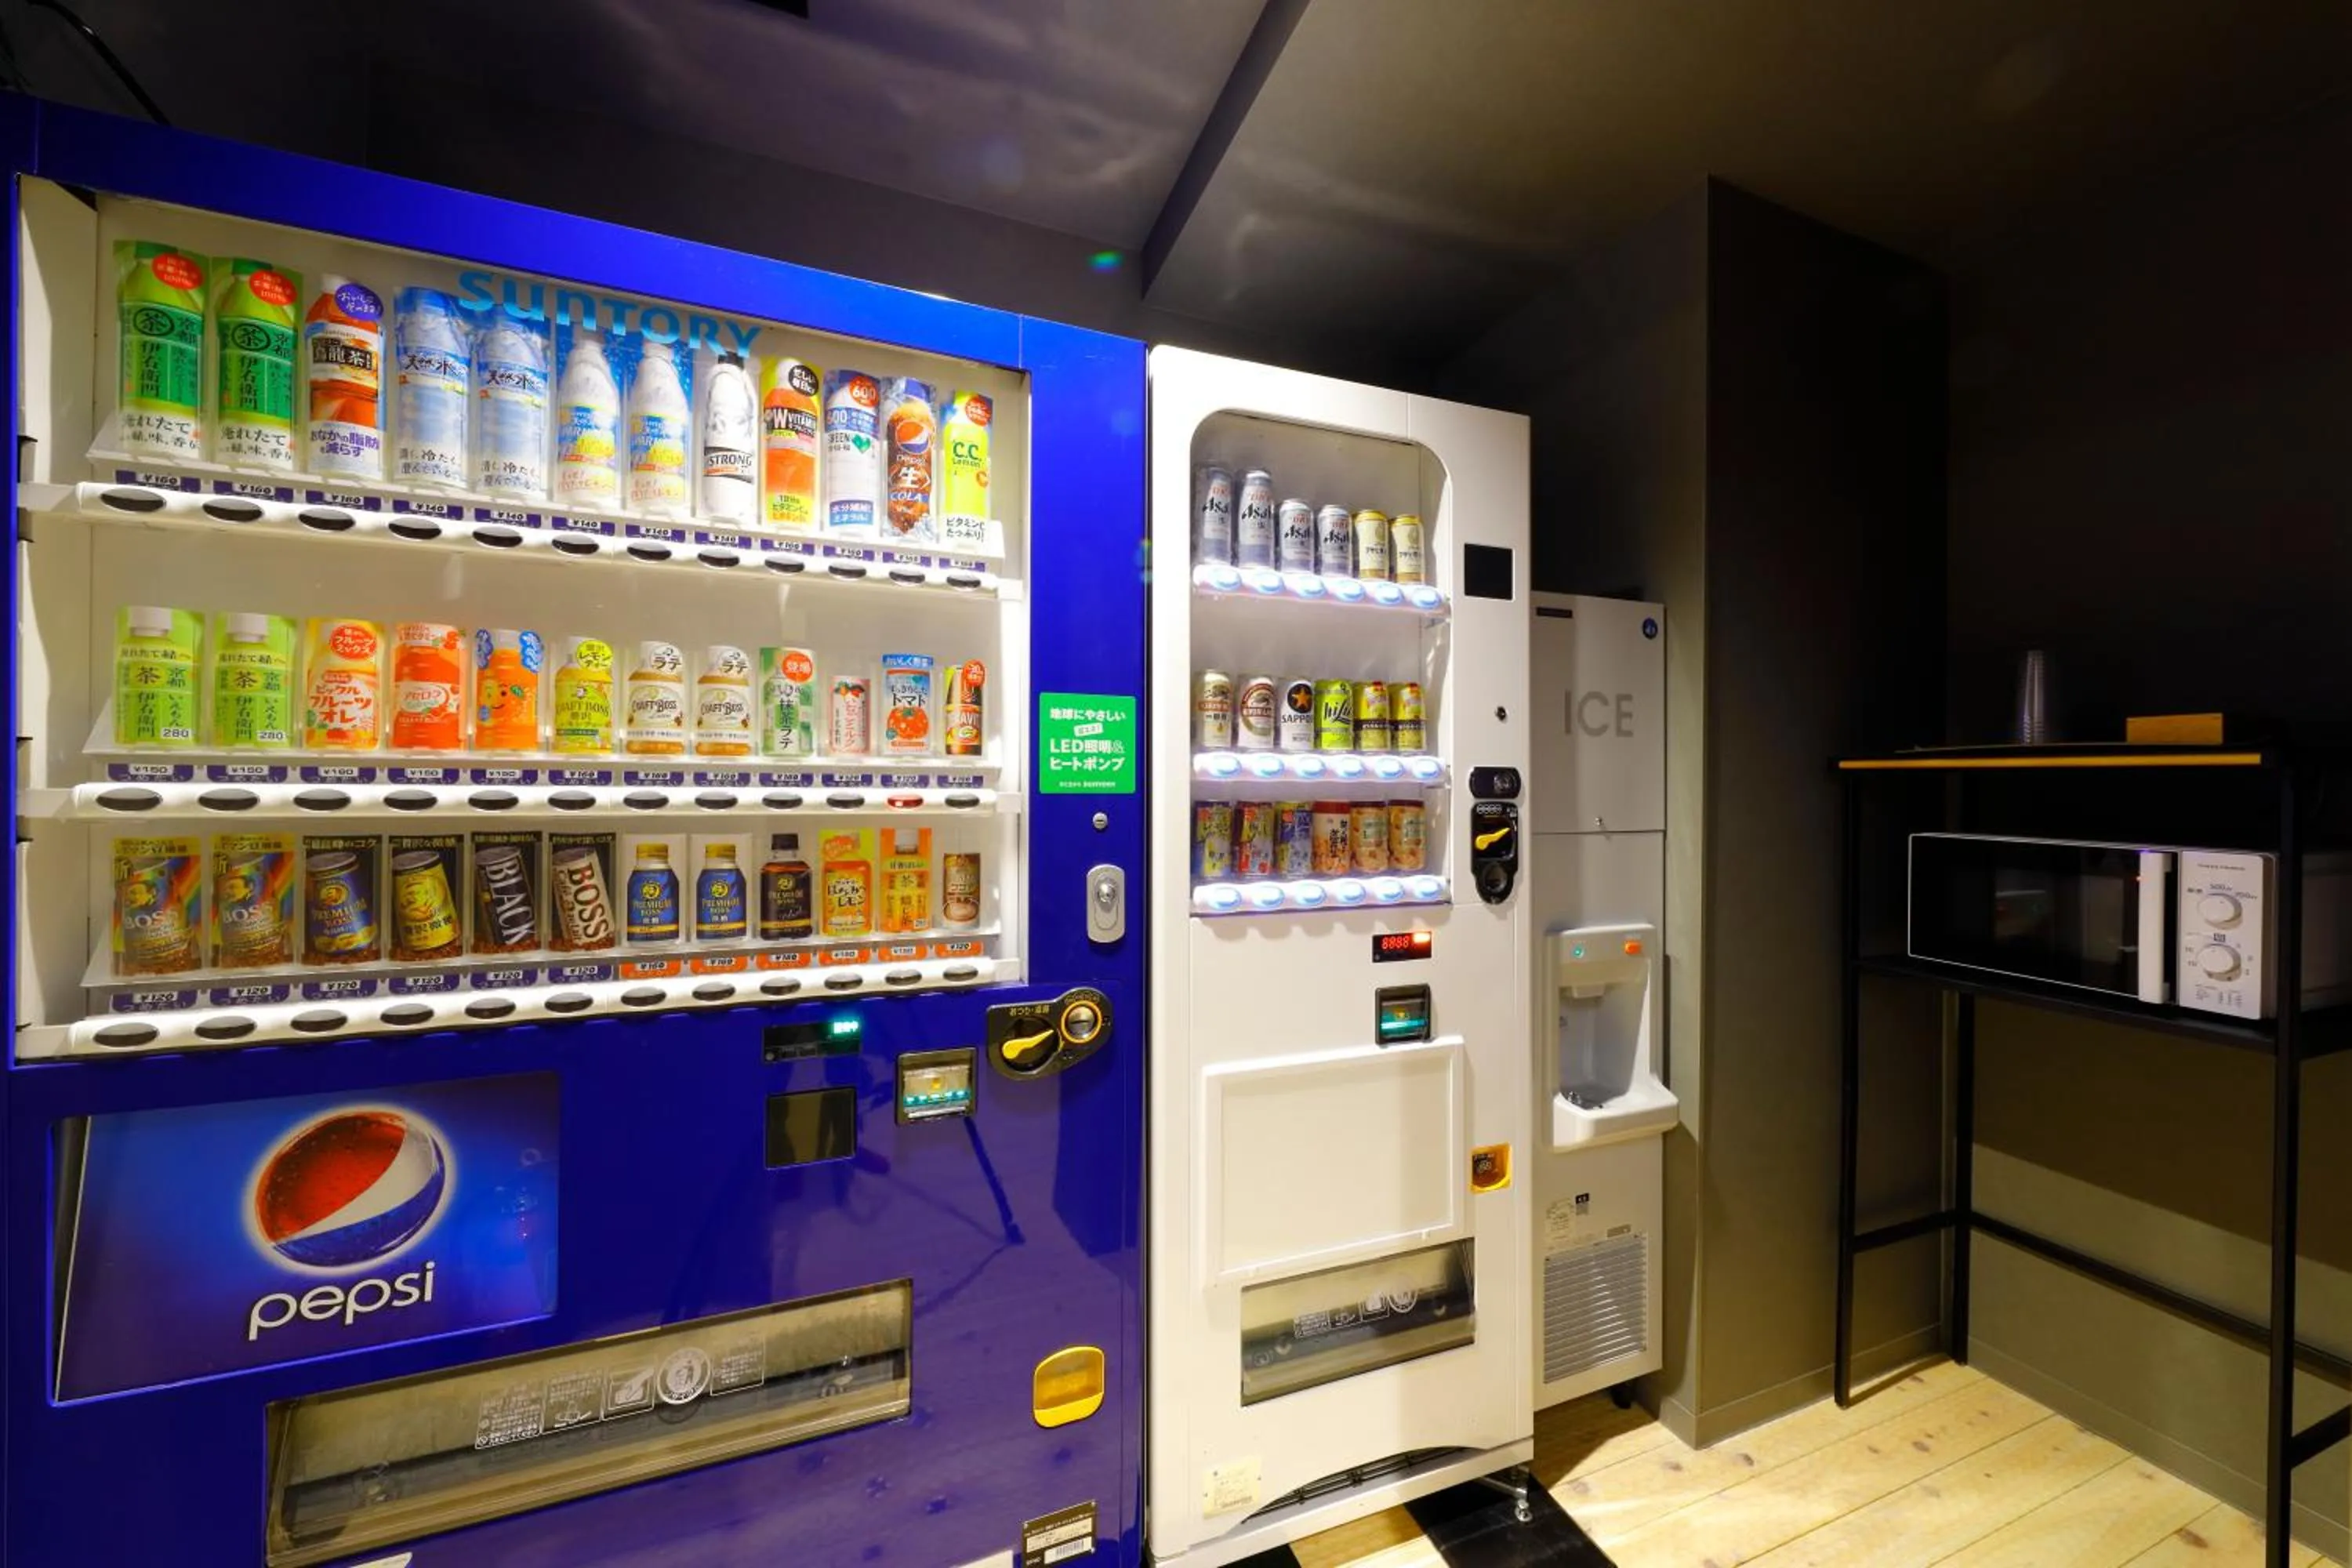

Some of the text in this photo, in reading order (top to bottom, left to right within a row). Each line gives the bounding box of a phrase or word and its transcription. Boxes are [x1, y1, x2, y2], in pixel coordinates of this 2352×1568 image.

[458, 270, 762, 358] SUNTORY
[708, 452, 752, 467] STRONG
[579, 651, 611, 660] レモン
[652, 656, 681, 671] ラテ
[721, 660, 750, 674] ラテ
[136, 666, 162, 684] 茶
[236, 670, 258, 688] 茶
[309, 695, 372, 710] フルーツ
[893, 693, 926, 708] トマト
[319, 709, 354, 724] オレ
[1050, 707, 1127, 722] 地球にやさしい
[1564, 691, 1634, 738] ICE
[162, 728, 190, 738] 280
[1050, 756, 1126, 771] ヒートポンプ
[485, 859, 537, 945] BLACK
[567, 862, 610, 938] BOSS
[492, 971, 521, 979] ¥120
[140, 991, 175, 1003] ¥120
[236, 985, 268, 996] ¥120
[248, 1261, 436, 1341] pepsi
